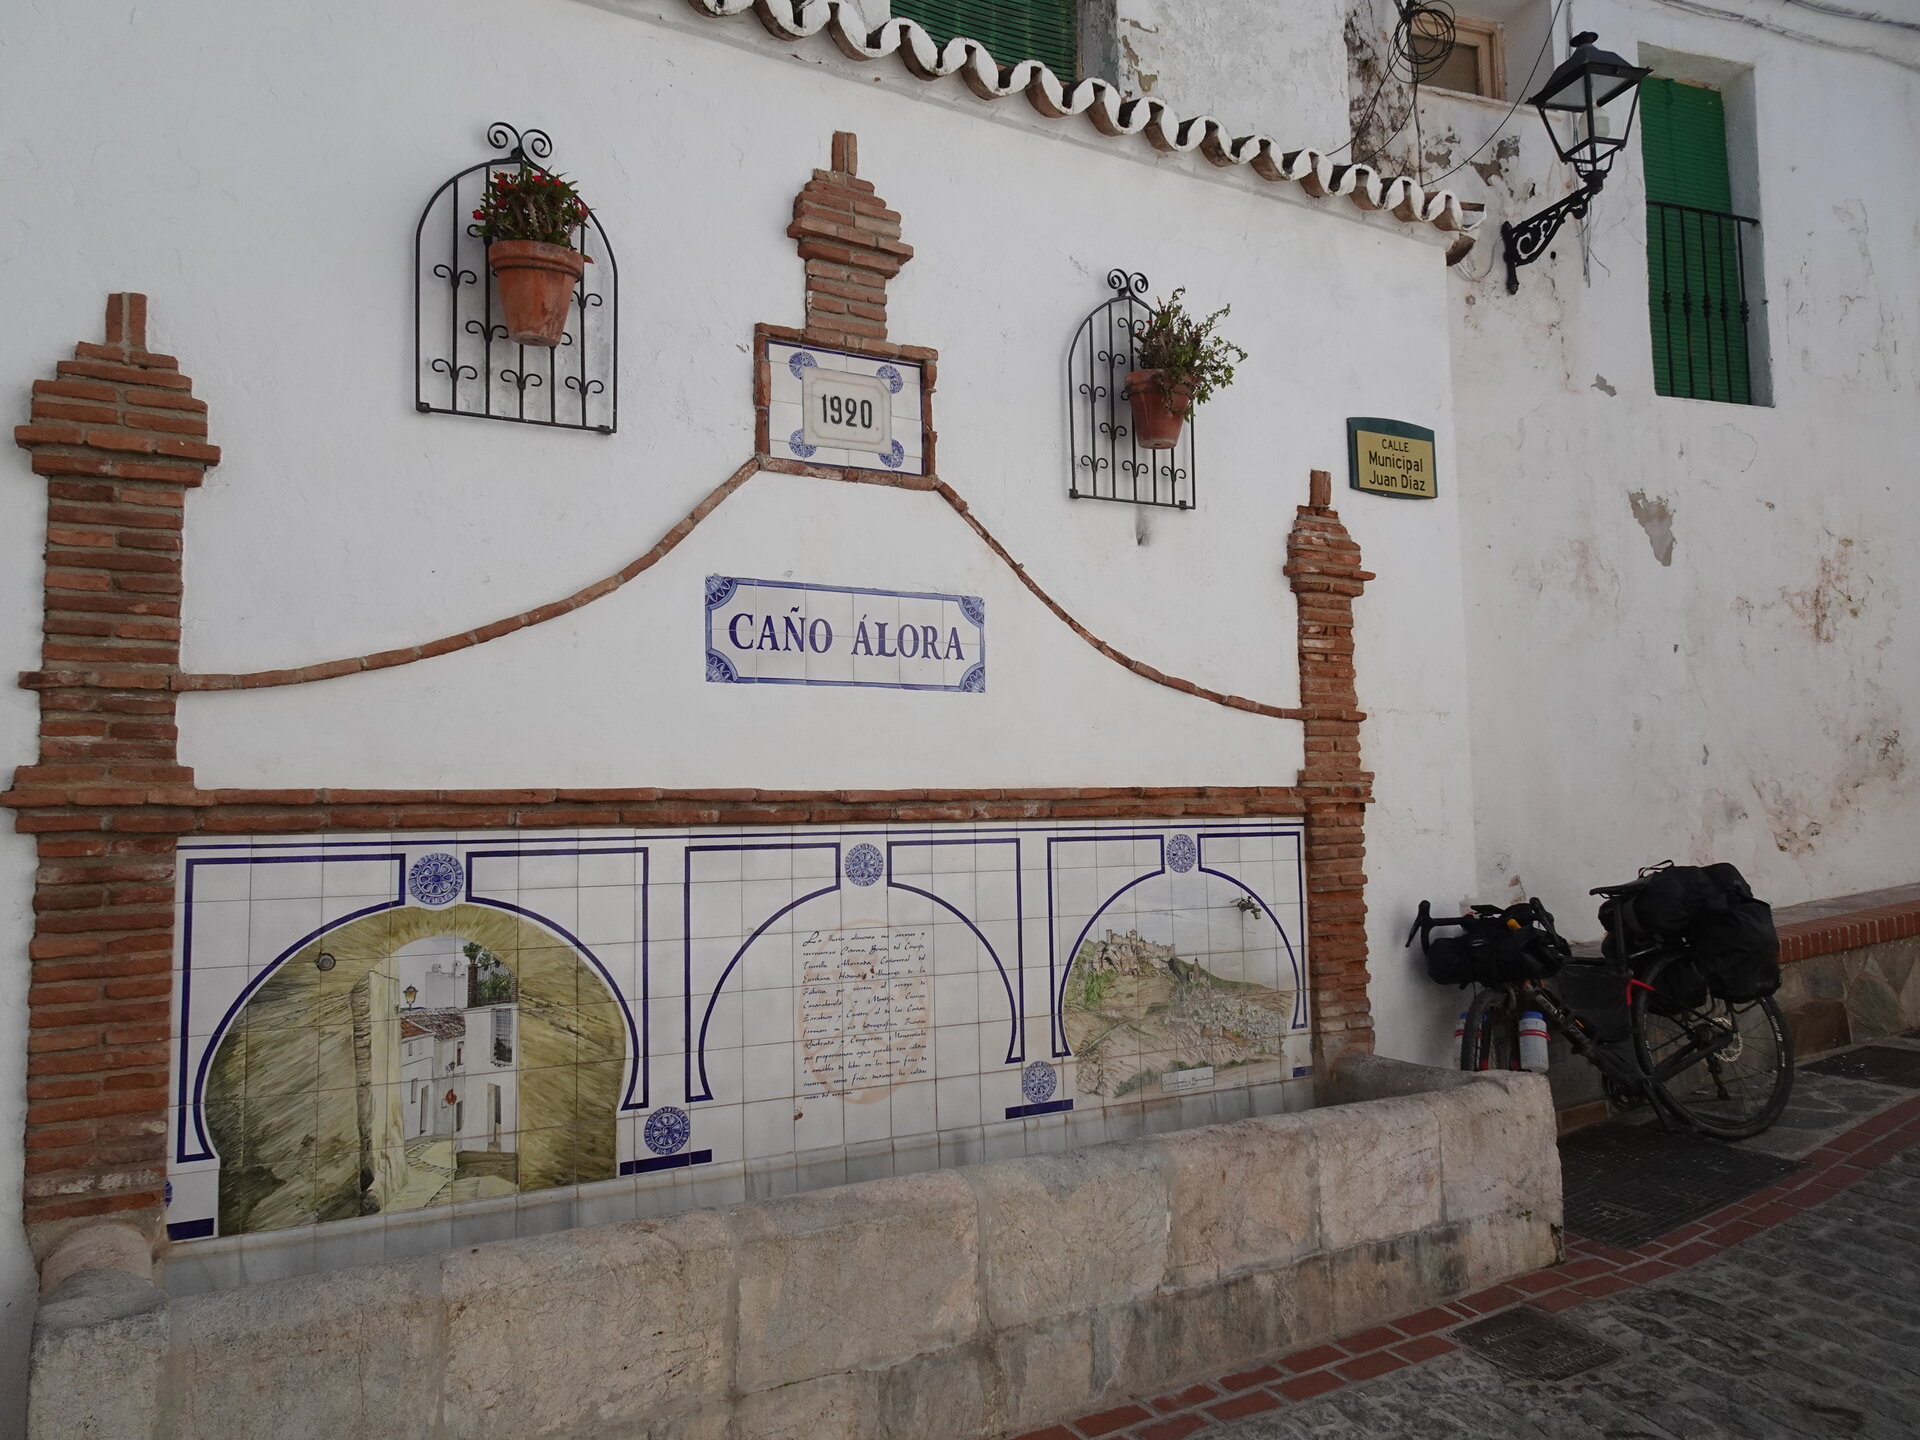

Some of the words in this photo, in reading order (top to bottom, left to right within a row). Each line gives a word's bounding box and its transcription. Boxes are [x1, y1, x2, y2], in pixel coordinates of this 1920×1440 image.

[821, 393, 872, 429] 1920
[1381, 438, 1409, 452] CALLE
[1368, 450, 1423, 474] Municipal
[1369, 470, 1397, 487] Juan
[1401, 474, 1426, 491] Díaz
[728, 606, 834, 654] CAÑO
[851, 614, 965, 661] ÁLORA
